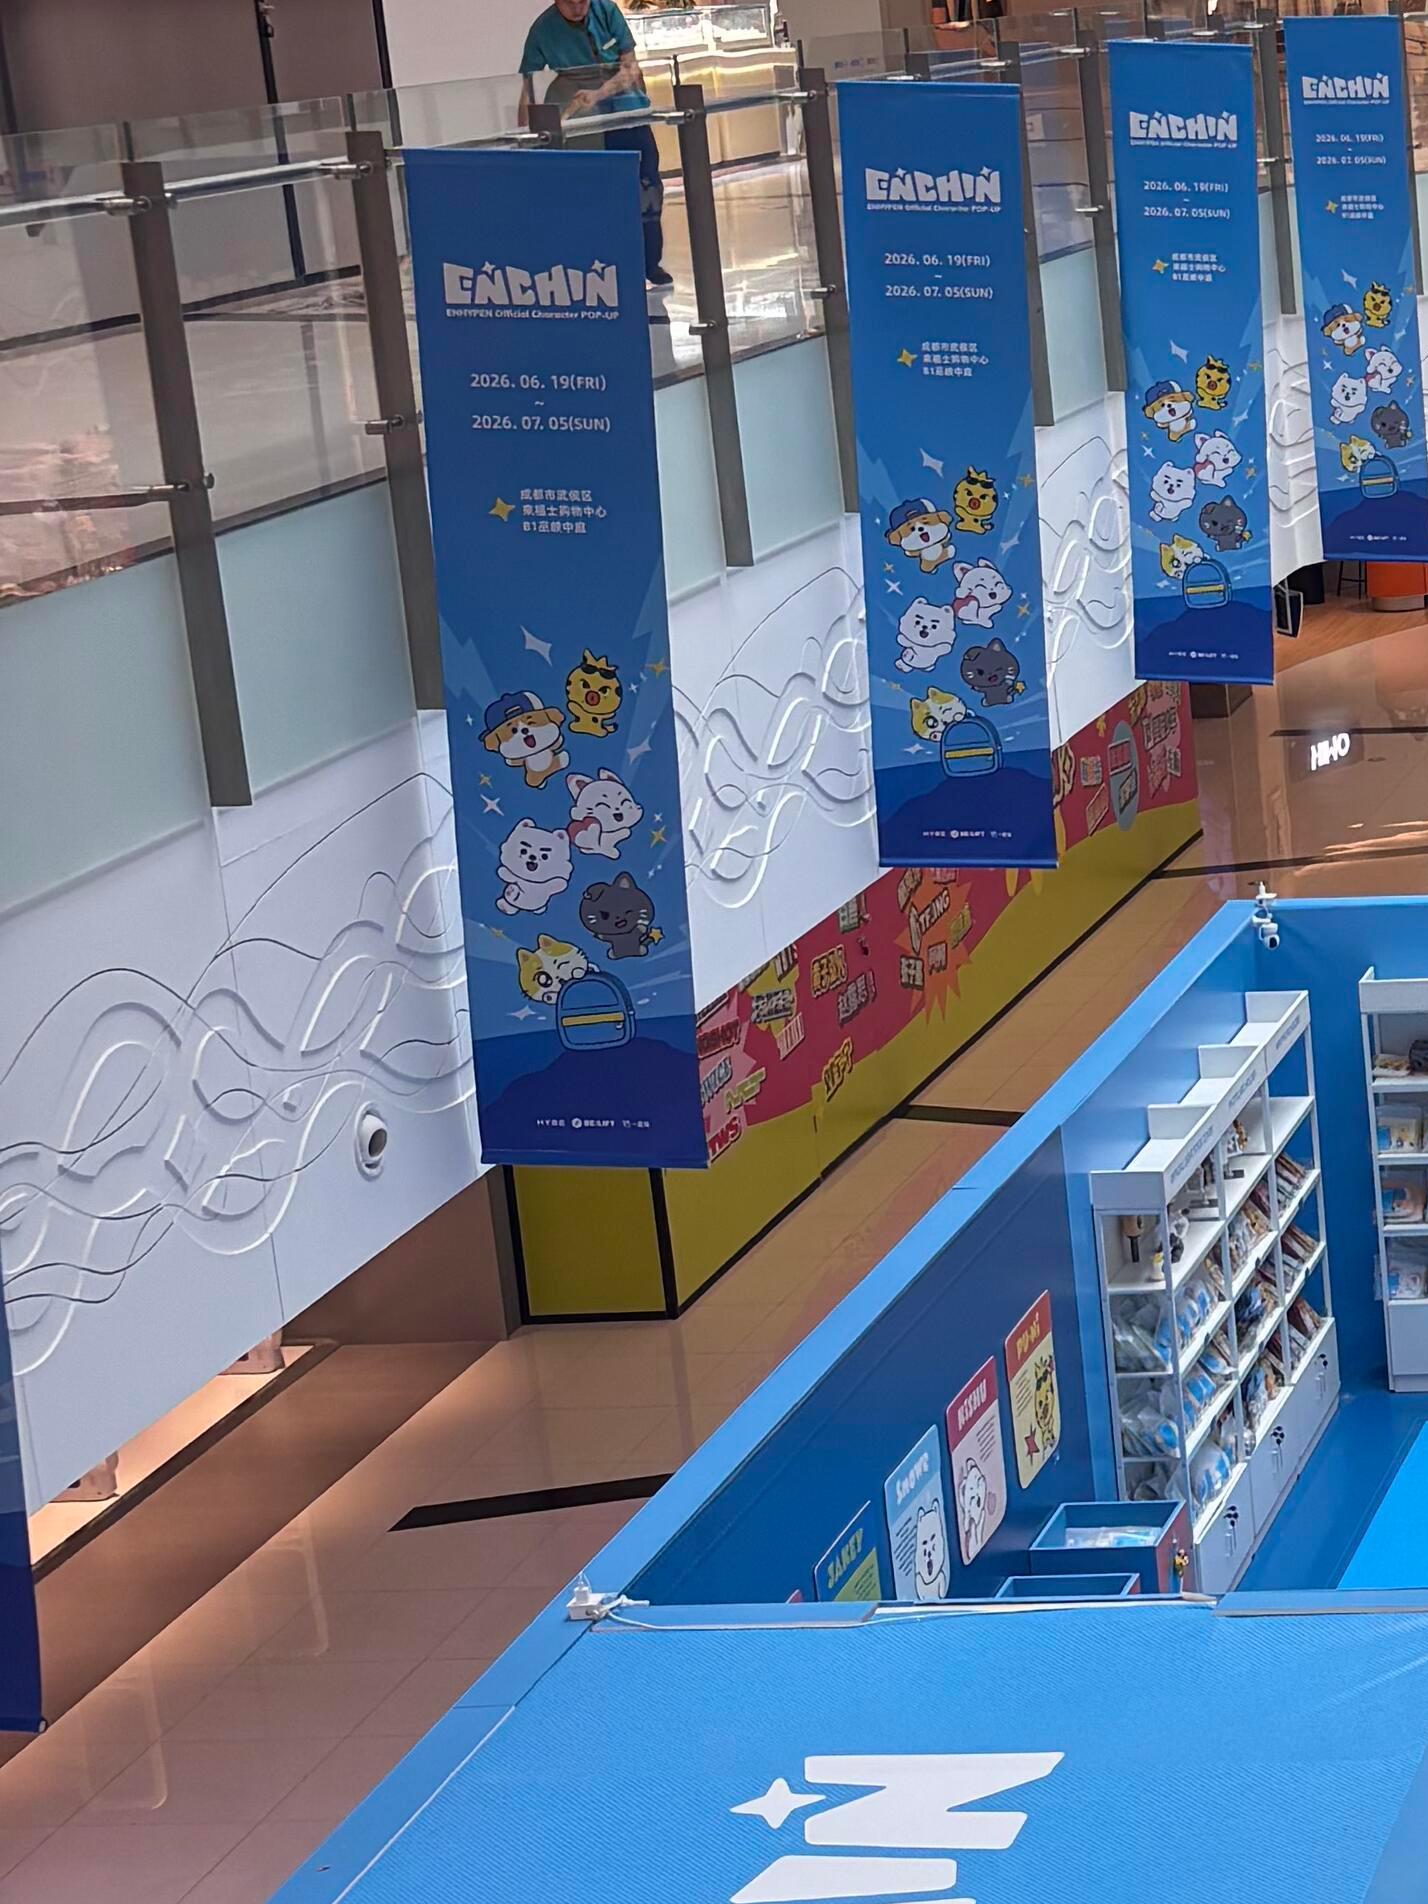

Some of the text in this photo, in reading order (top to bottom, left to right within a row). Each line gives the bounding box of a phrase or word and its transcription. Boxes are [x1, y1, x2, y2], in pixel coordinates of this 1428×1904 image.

[1302, 72, 1390, 99] ENCHIN
[1129, 111, 1238, 141] ENCHIN
[865, 166, 1001, 203] ENCHIN
[884, 253, 991, 268] 2026. 06. 19(FRI)
[443, 260, 619, 307] ENCHIN
[885, 285, 993, 299] 2026. 07. 05(SUN)
[470, 374, 607, 391] 2026. 06. 19(FRI)
[472, 415, 611, 432] 2026. 07. 05(SUN)
